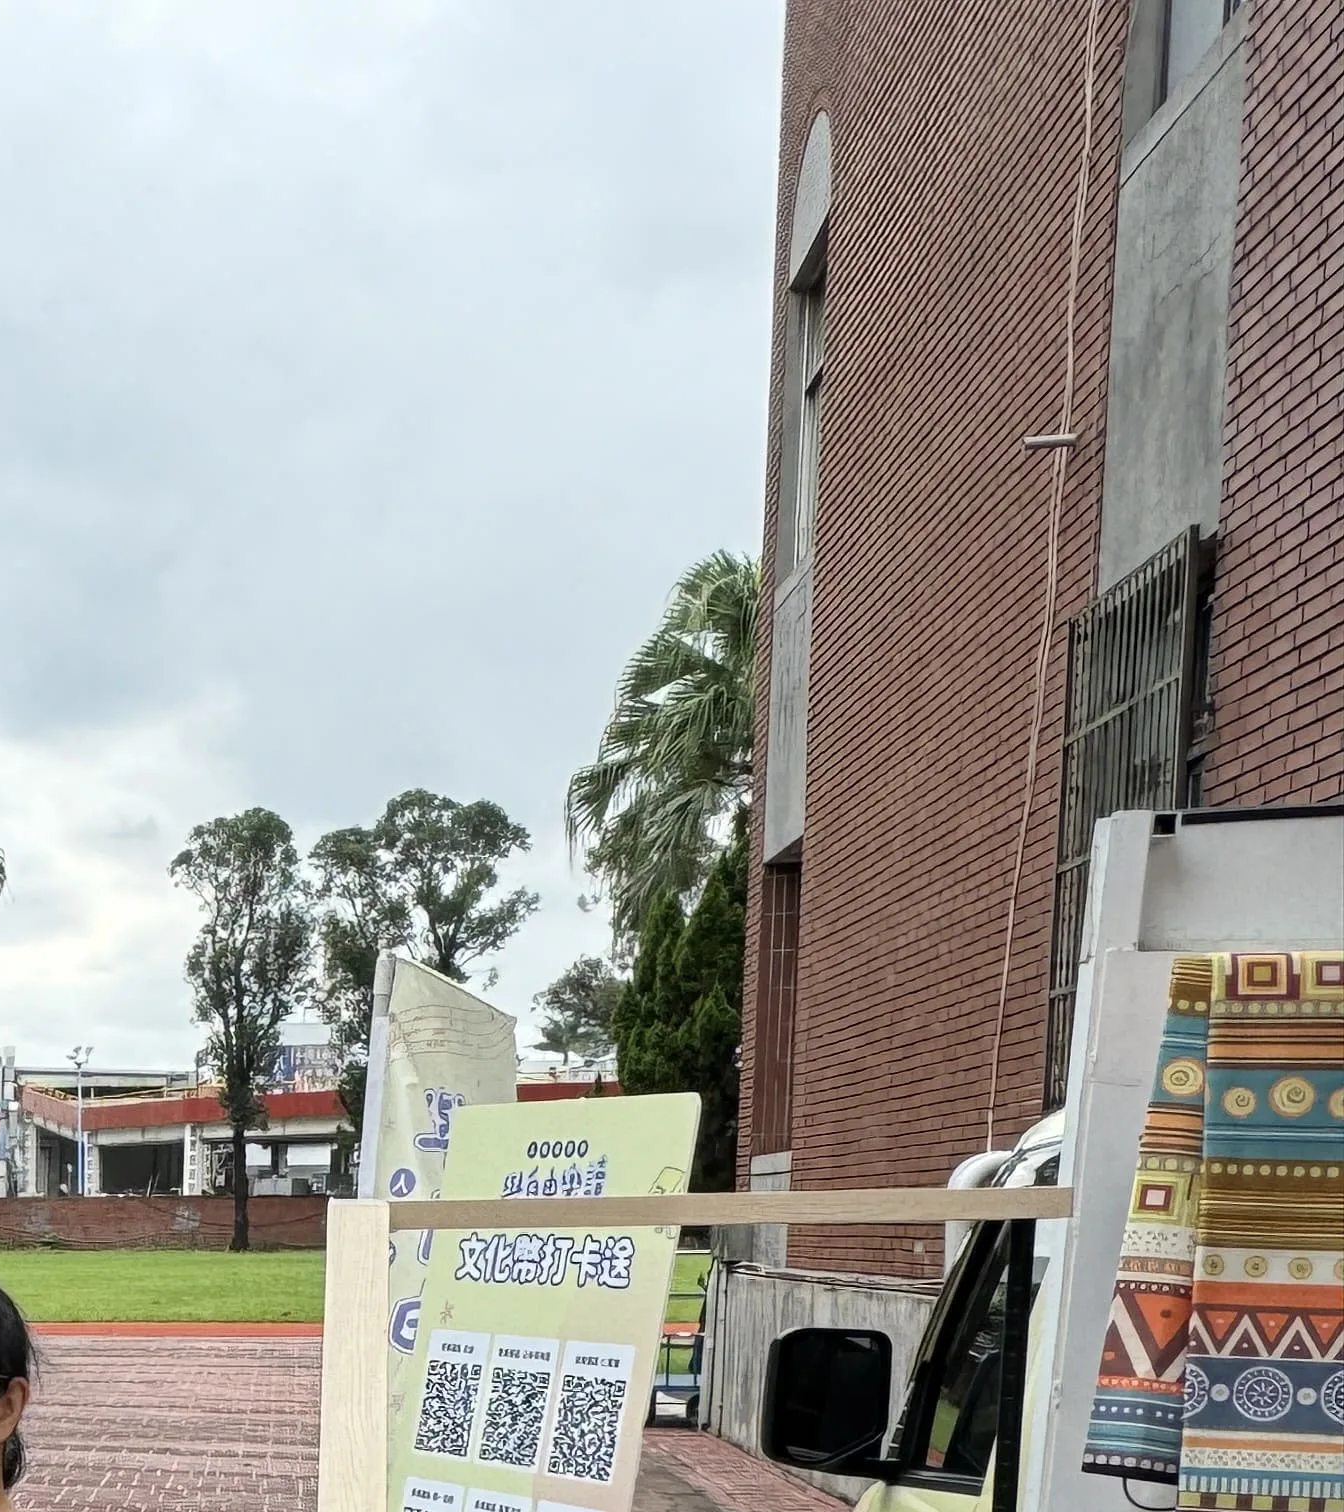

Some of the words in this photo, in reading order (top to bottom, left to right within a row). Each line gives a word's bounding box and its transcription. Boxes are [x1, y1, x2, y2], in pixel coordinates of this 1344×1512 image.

[455, 1231, 635, 1288] 文化幣打卡送
